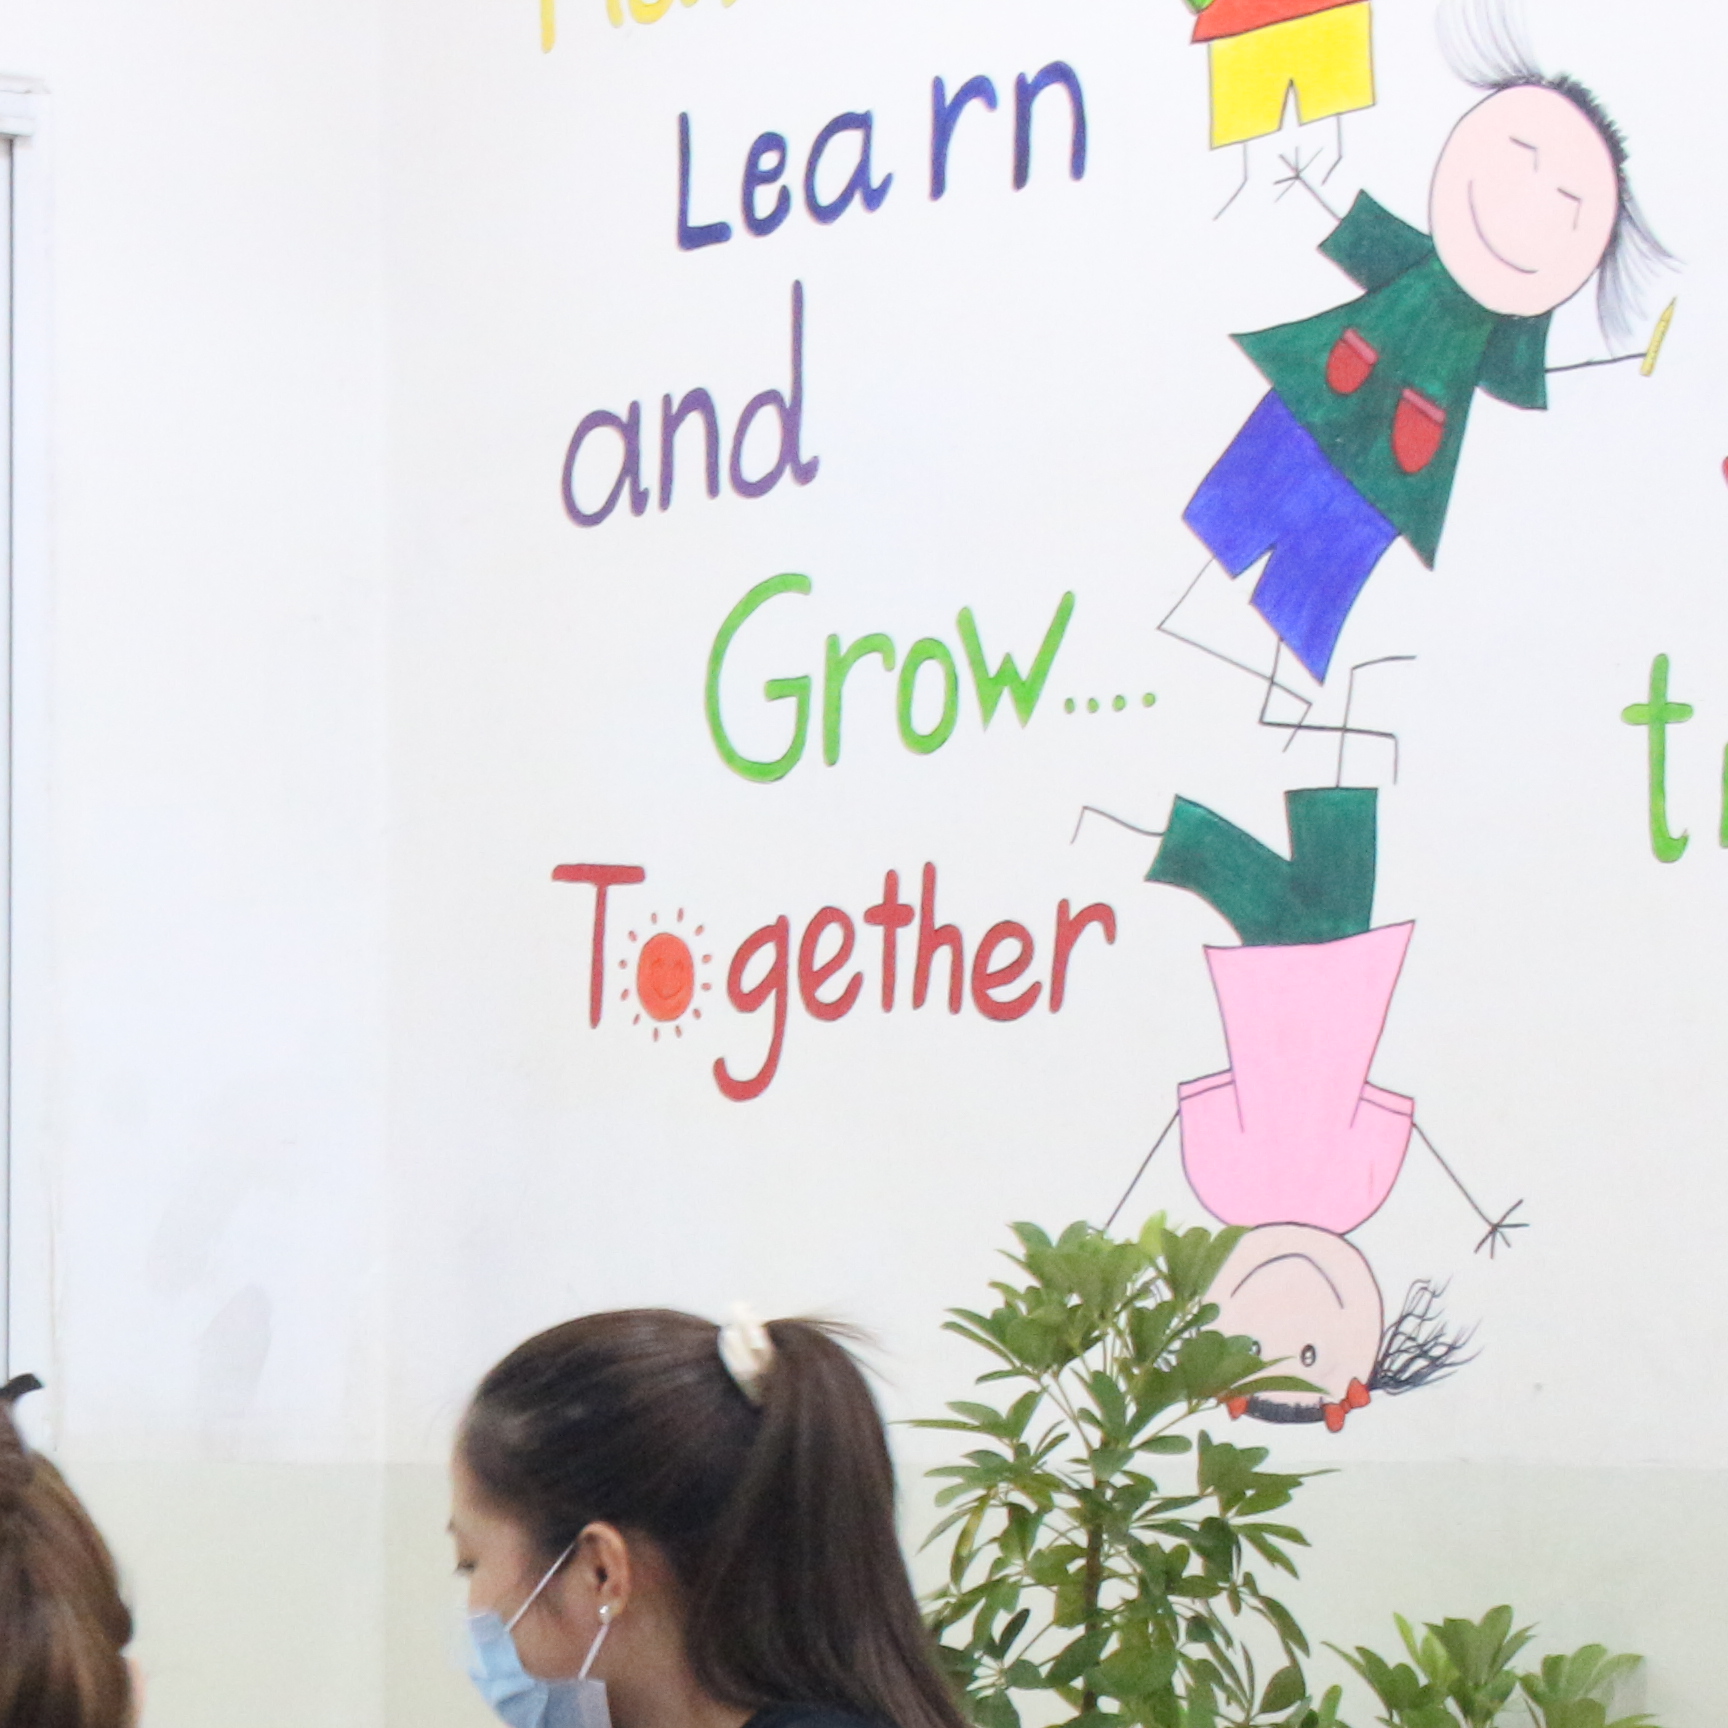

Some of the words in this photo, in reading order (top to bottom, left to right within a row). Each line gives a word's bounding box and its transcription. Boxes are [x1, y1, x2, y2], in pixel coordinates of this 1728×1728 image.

[675, 60, 1087, 251] Learn
[560, 279, 819, 527] and
[551, 861, 1116, 1101] Together
